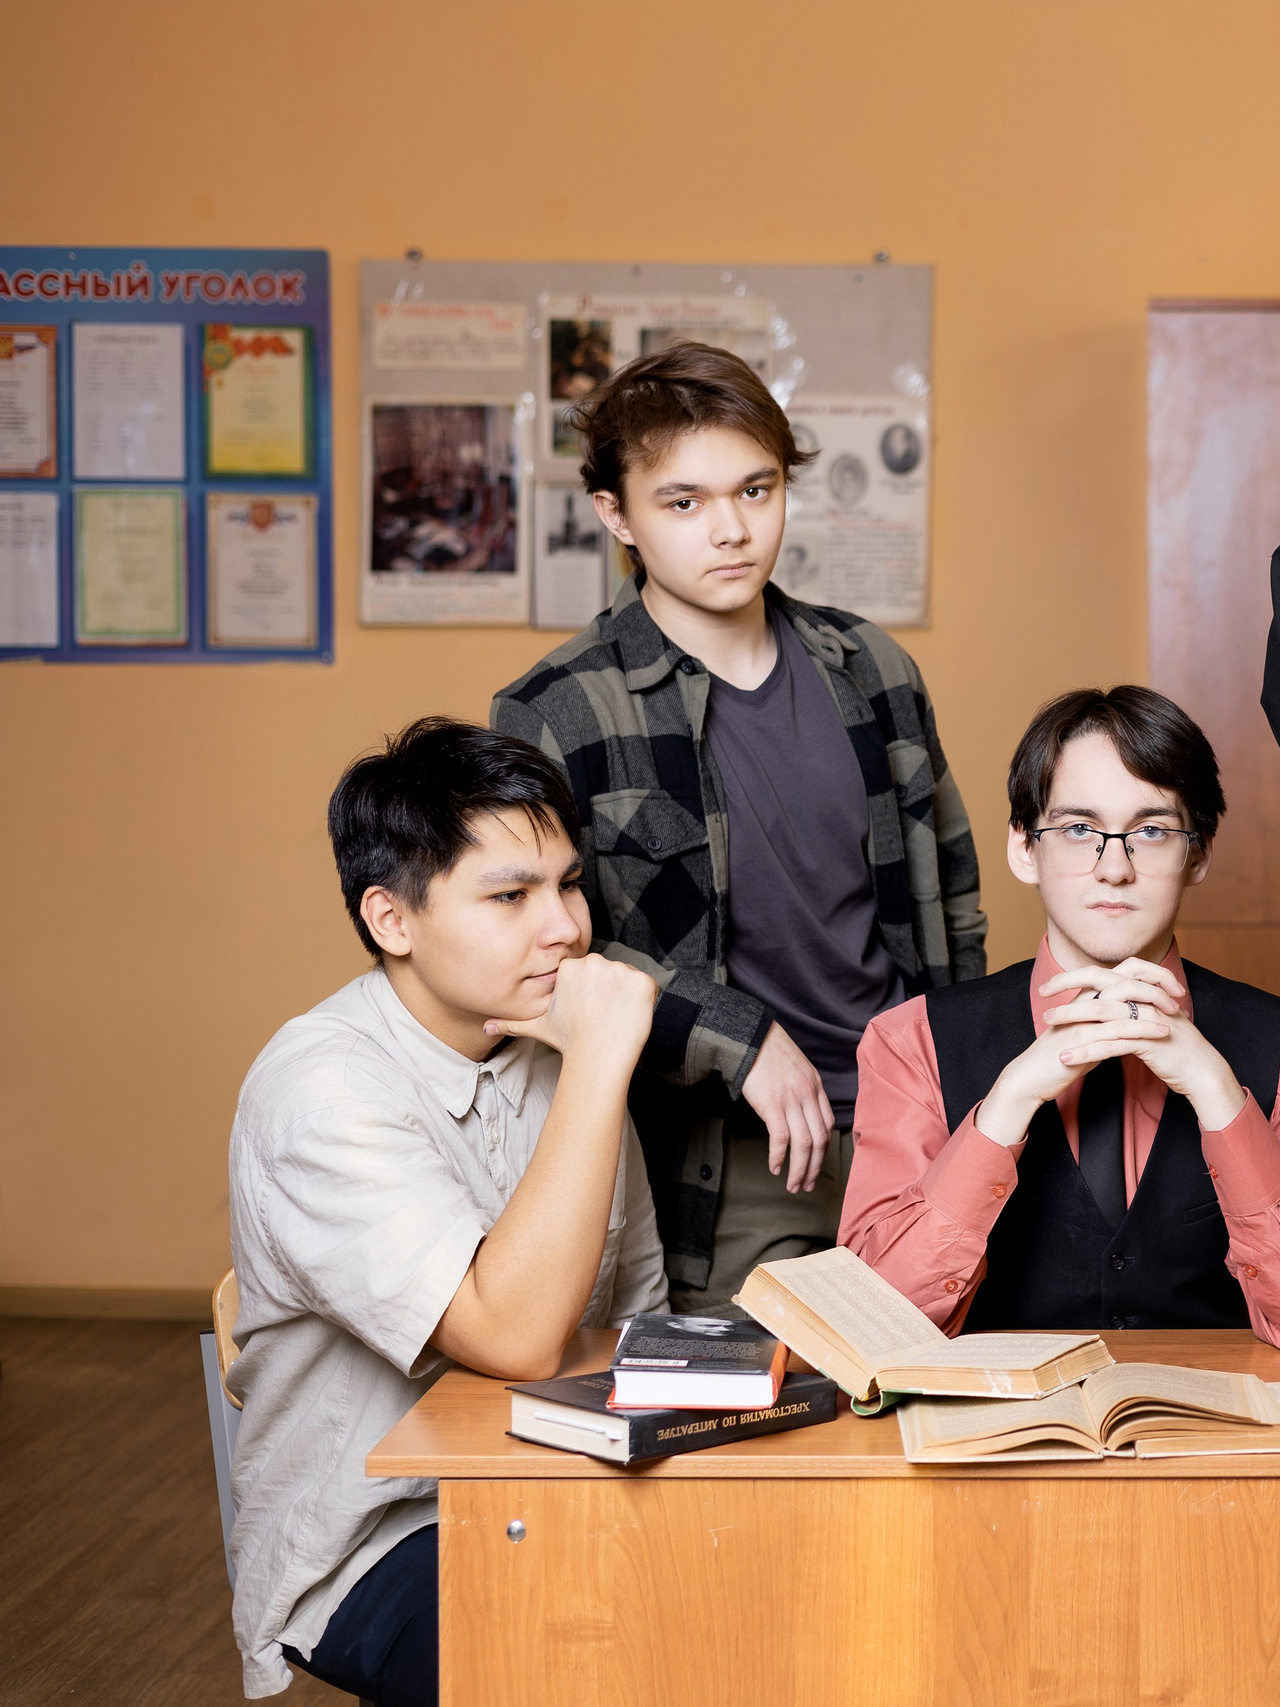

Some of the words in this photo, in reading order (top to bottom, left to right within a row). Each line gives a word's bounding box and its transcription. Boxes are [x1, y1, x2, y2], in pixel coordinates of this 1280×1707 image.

[161, 273, 303, 299] УГОЛОК
[722, 1415, 736, 1428] ПО
[740, 1401, 811, 1425] ХРЕСТОМАТИЯ
[656, 1418, 719, 1441] ЛИТЕРАТУРЕ
